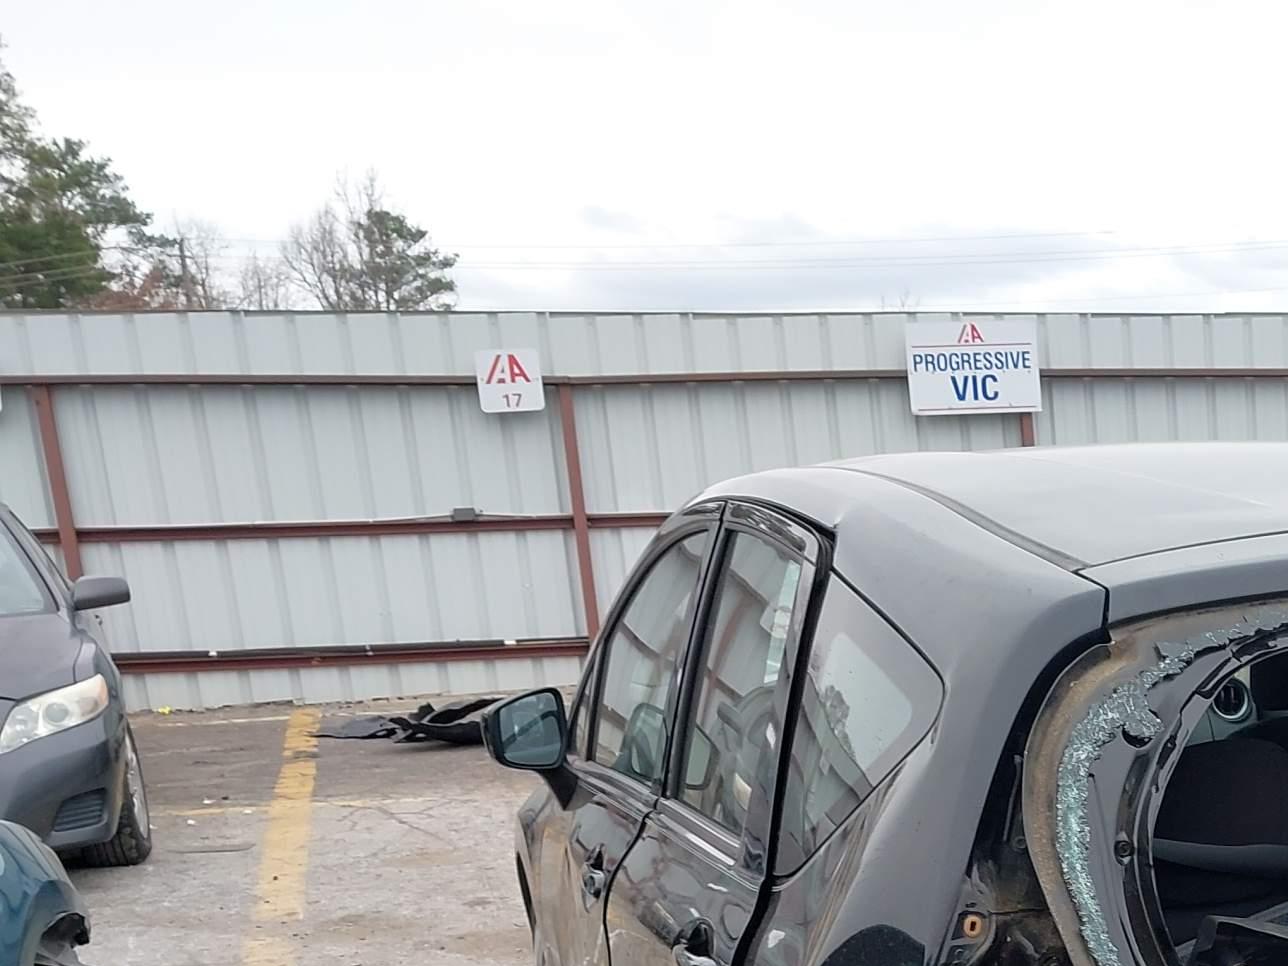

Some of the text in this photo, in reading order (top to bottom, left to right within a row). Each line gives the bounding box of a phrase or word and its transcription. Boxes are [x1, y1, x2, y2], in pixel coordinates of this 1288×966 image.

[913, 351, 1032, 373] PROGRESSIVE
[950, 374, 1000, 401] VIC
[502, 393, 522, 408] 17
